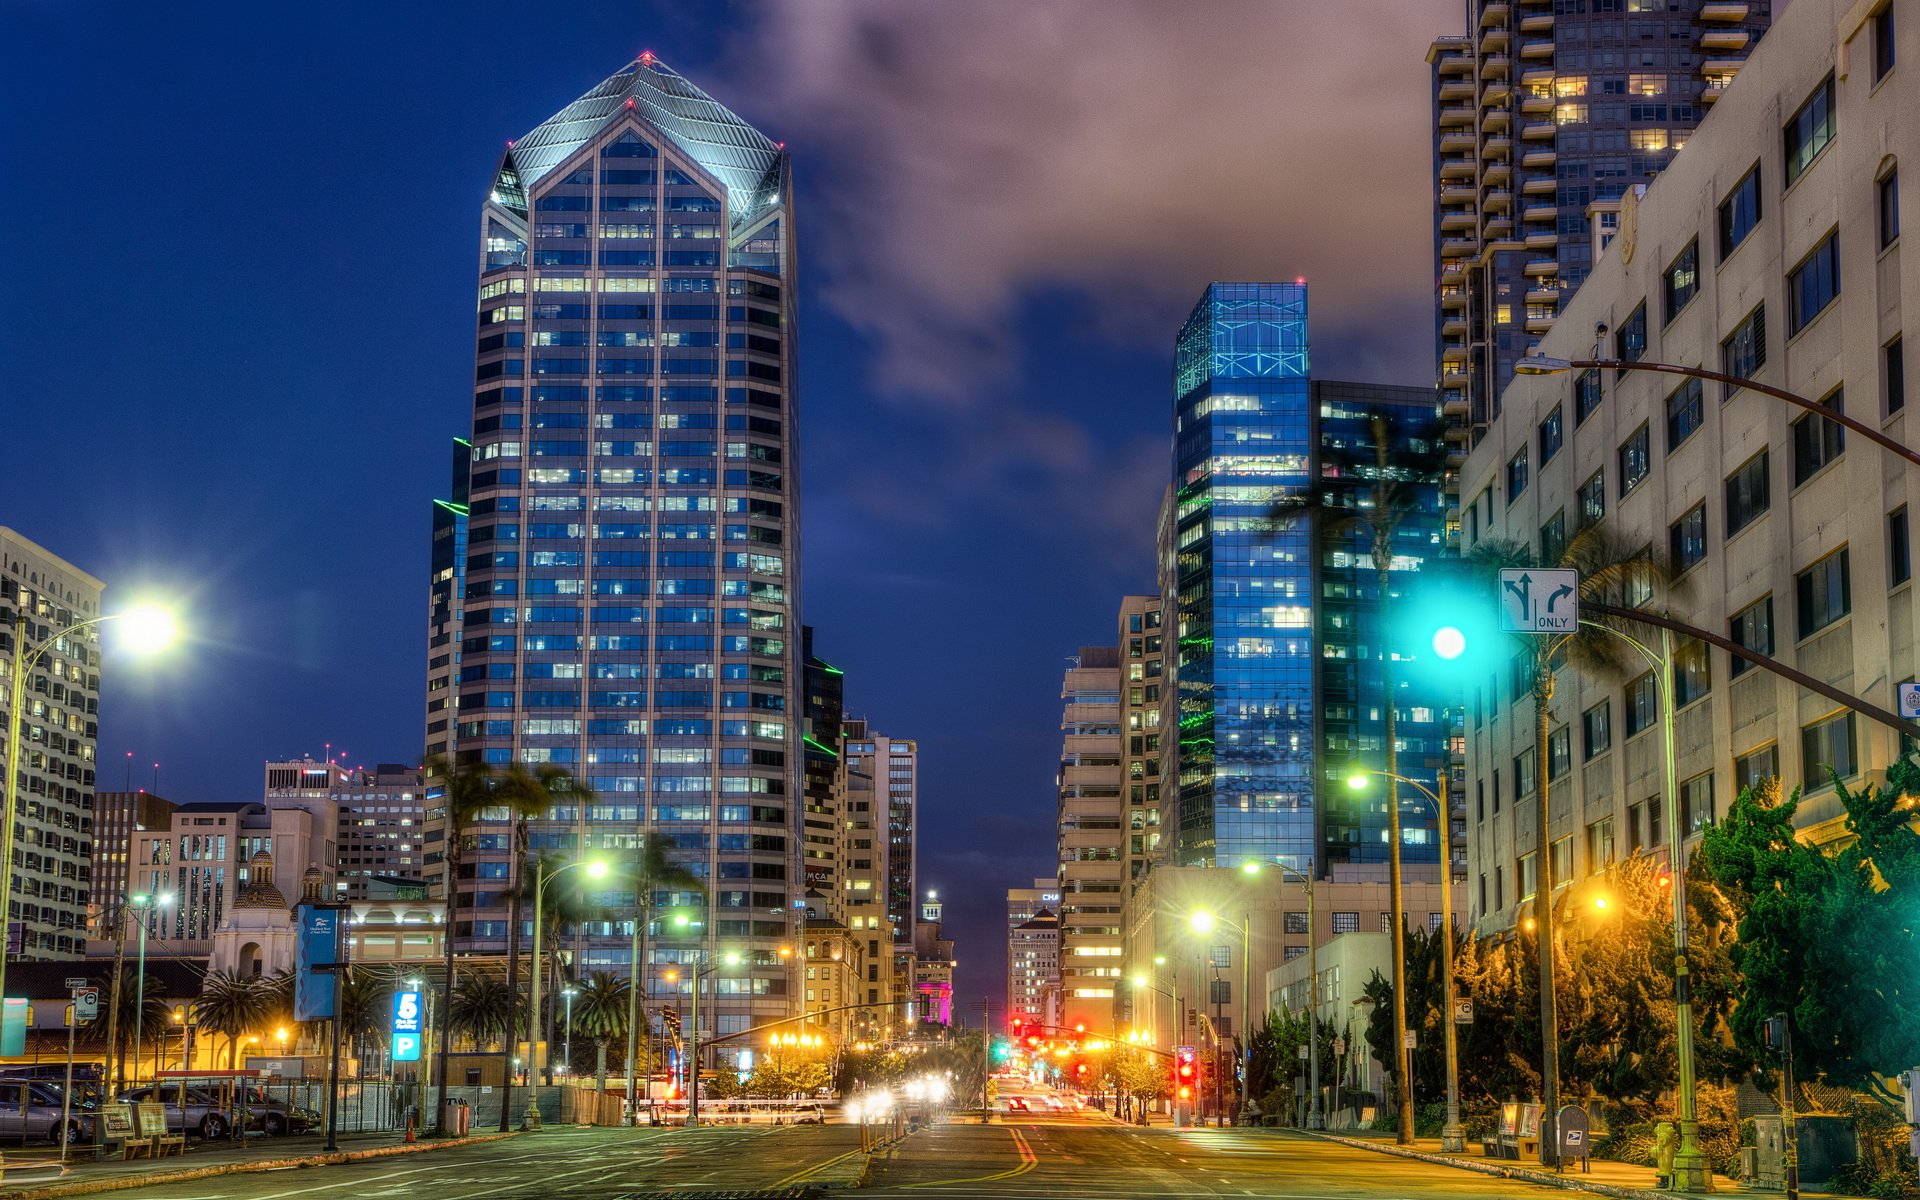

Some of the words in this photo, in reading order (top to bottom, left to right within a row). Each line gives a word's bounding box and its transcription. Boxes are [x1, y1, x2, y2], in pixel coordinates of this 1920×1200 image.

[1539, 617, 1568, 628] ONLY
[805, 872, 827, 880] MCA
[398, 994, 418, 1020] 5
[398, 1037, 414, 1057] P
